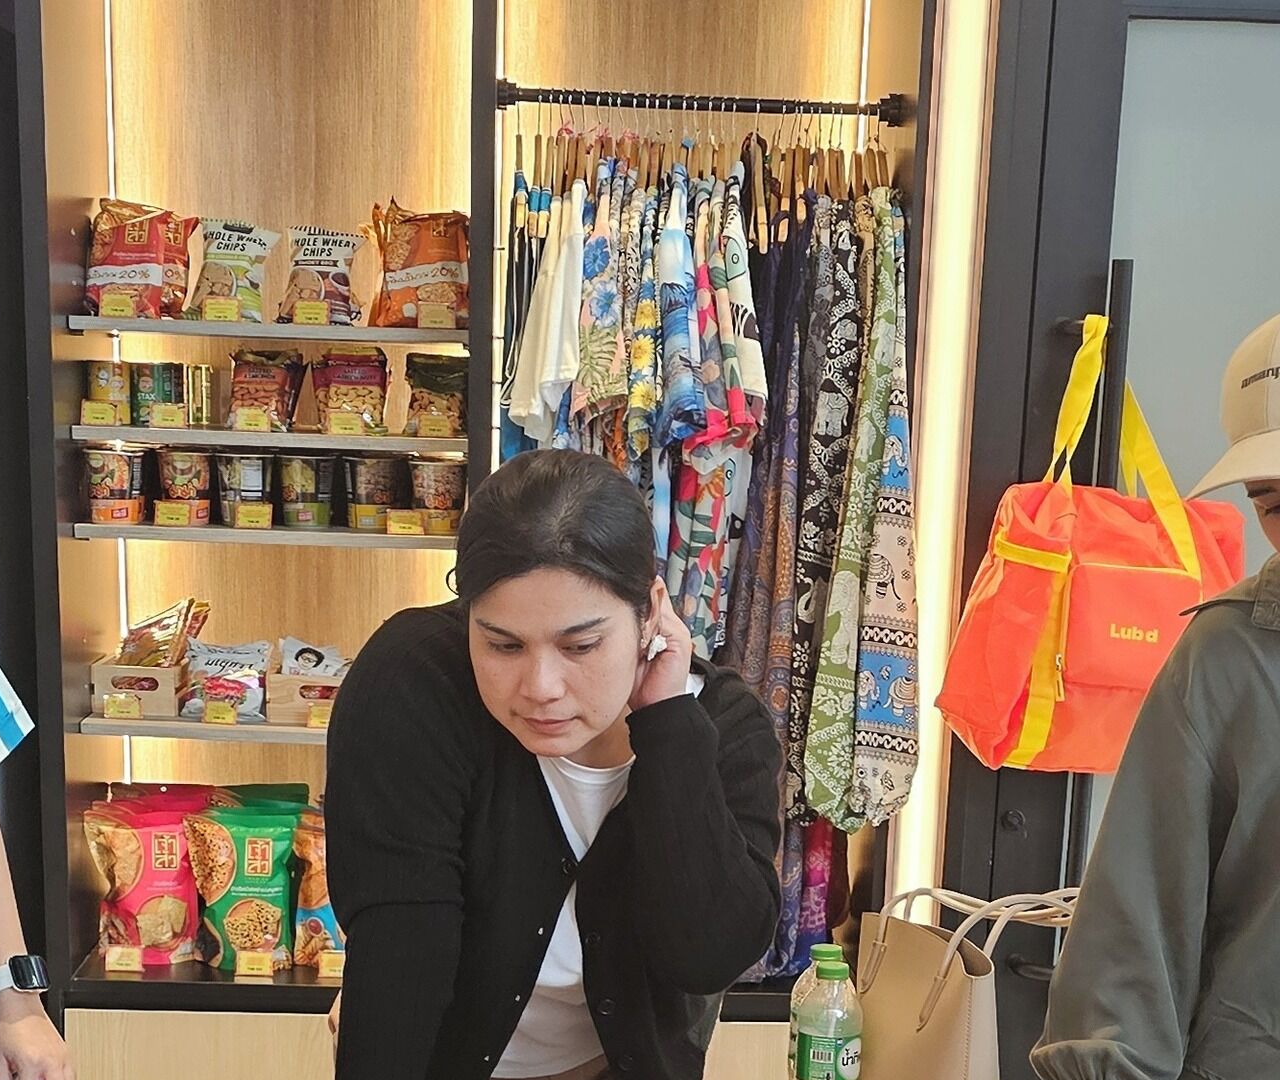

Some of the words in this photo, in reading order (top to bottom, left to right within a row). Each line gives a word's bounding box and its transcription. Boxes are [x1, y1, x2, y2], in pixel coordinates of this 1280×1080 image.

[207, 230, 233, 242] HOLE
[216, 242, 247, 252] CHIPS
[293, 238, 319, 247] HOLE
[322, 238, 357, 249] WHEAT
[302, 247, 333, 257] CHIPS
[165, 269, 184, 280] 0%
[1110, 623, 1144, 640] Lub
[1145, 628, 1159, 643] d
